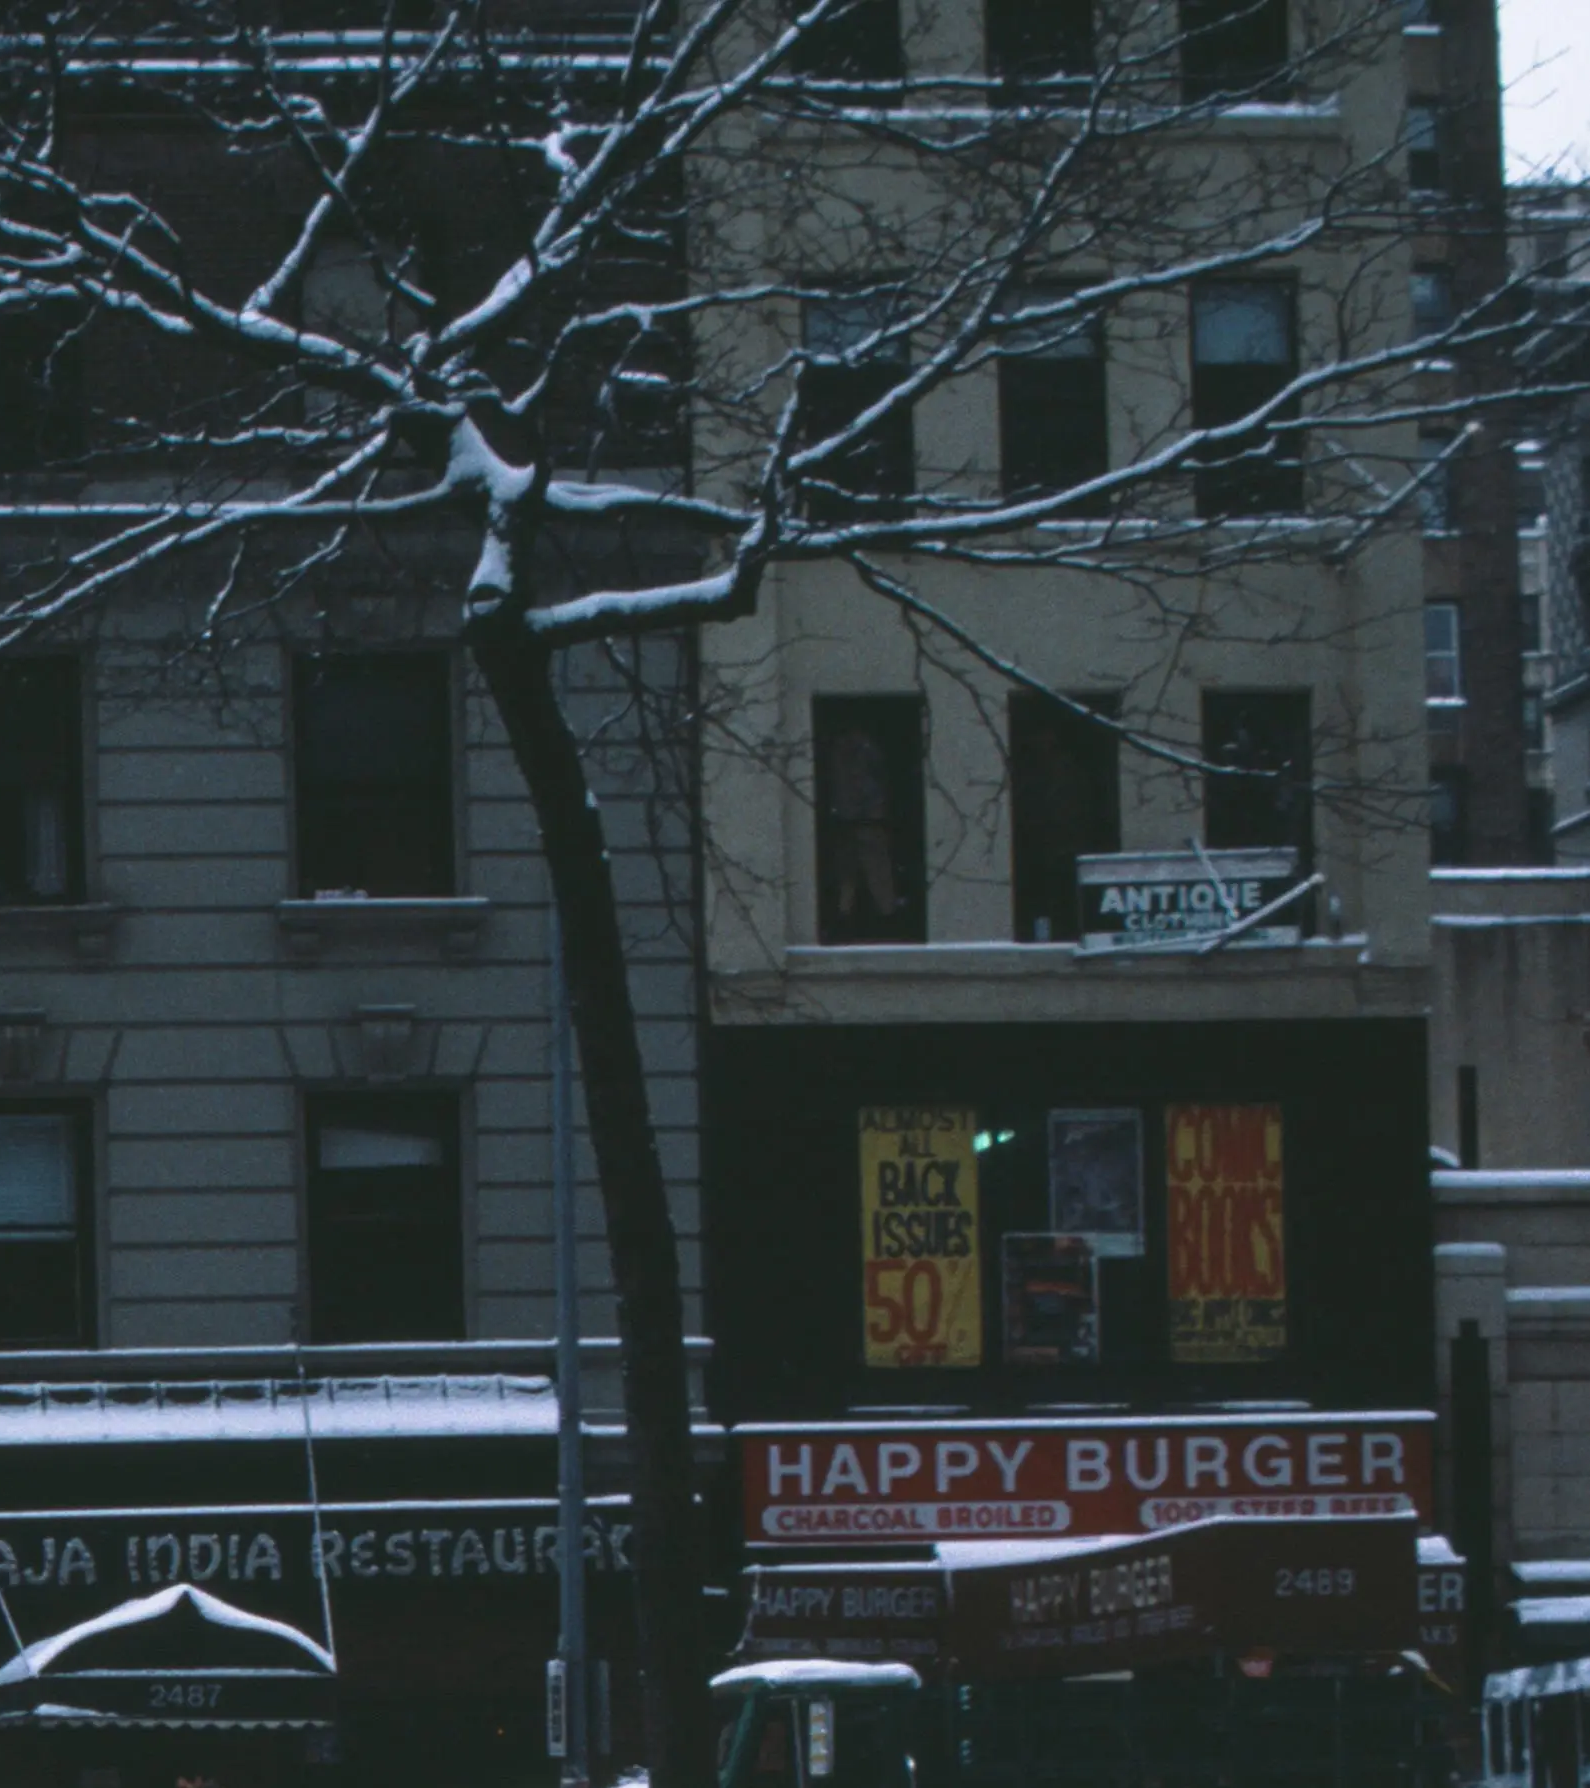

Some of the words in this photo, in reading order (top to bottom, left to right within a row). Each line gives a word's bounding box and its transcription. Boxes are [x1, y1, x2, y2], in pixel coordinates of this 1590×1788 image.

[1099, 881, 1263, 914] ANTIQUE
[878, 1161, 961, 1208] BACK
[873, 1211, 973, 1259] ISSUES
[767, 1440, 1033, 1496] HAPPY
[1066, 1433, 1405, 1491] BURGER
[776, 1508, 927, 1532] CHARCOAL
[936, 1504, 1059, 1529] BROILED
[125, 1531, 282, 1585] INDIA
[1011, 1571, 1080, 1624] HAPPY
[1090, 1554, 1173, 1615] BURGER
[1275, 1568, 1355, 1596] 2489
[755, 1588, 834, 1618] HAPPY
[842, 1587, 938, 1618] BURGER
[149, 1684, 223, 1709] 2487
